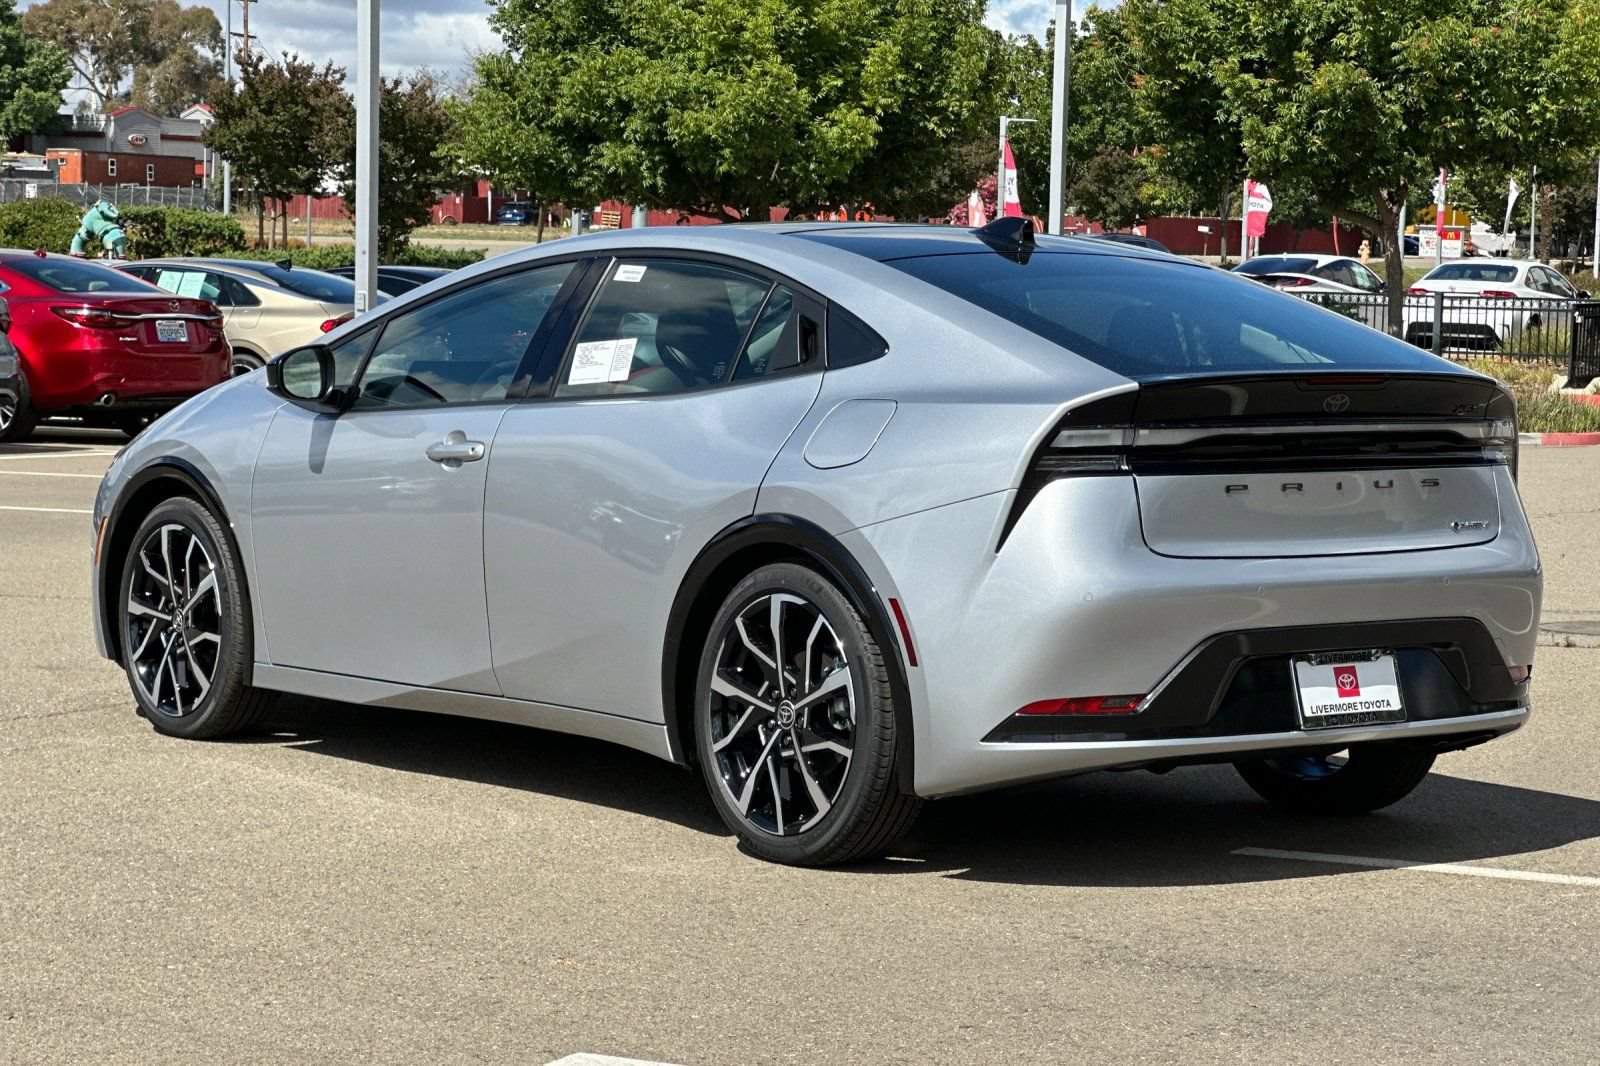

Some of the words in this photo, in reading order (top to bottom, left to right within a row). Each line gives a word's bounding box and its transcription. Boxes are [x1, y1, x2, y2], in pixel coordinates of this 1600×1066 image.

[1225, 478, 1440, 494] PRIUS
[1311, 702, 1358, 715] LIVERMORE
[1360, 700, 1391, 711] TOYOTA
